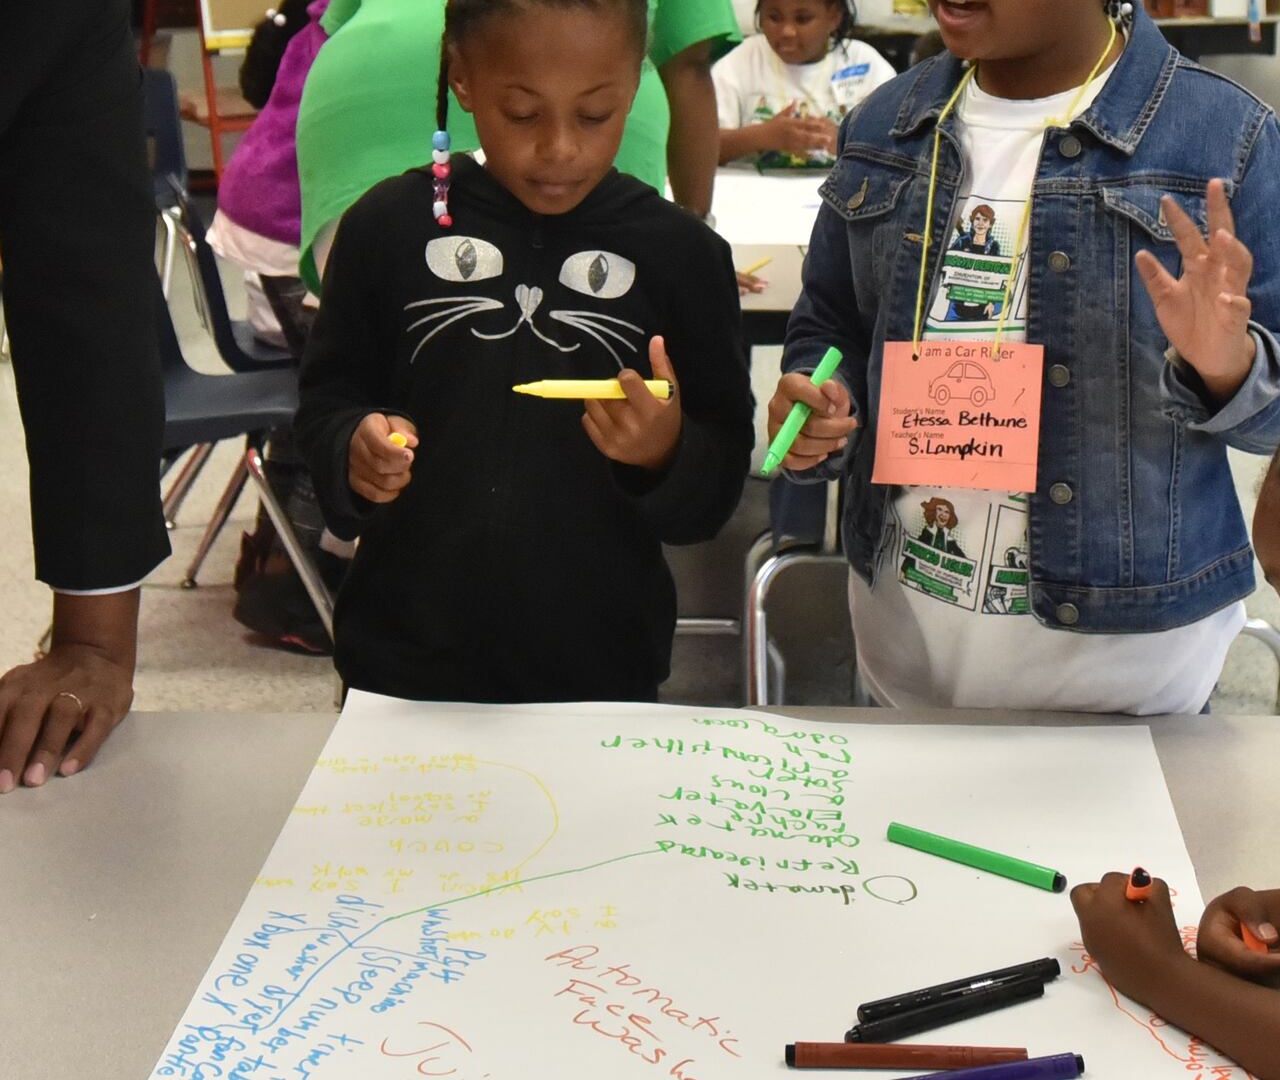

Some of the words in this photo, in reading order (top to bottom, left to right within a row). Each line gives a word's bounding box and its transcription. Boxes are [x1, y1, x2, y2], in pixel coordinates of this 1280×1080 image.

[924, 348, 943, 358] am
[955, 346, 978, 358] Car
[925, 408, 946, 416] Name
[923, 431, 945, 440] Name
